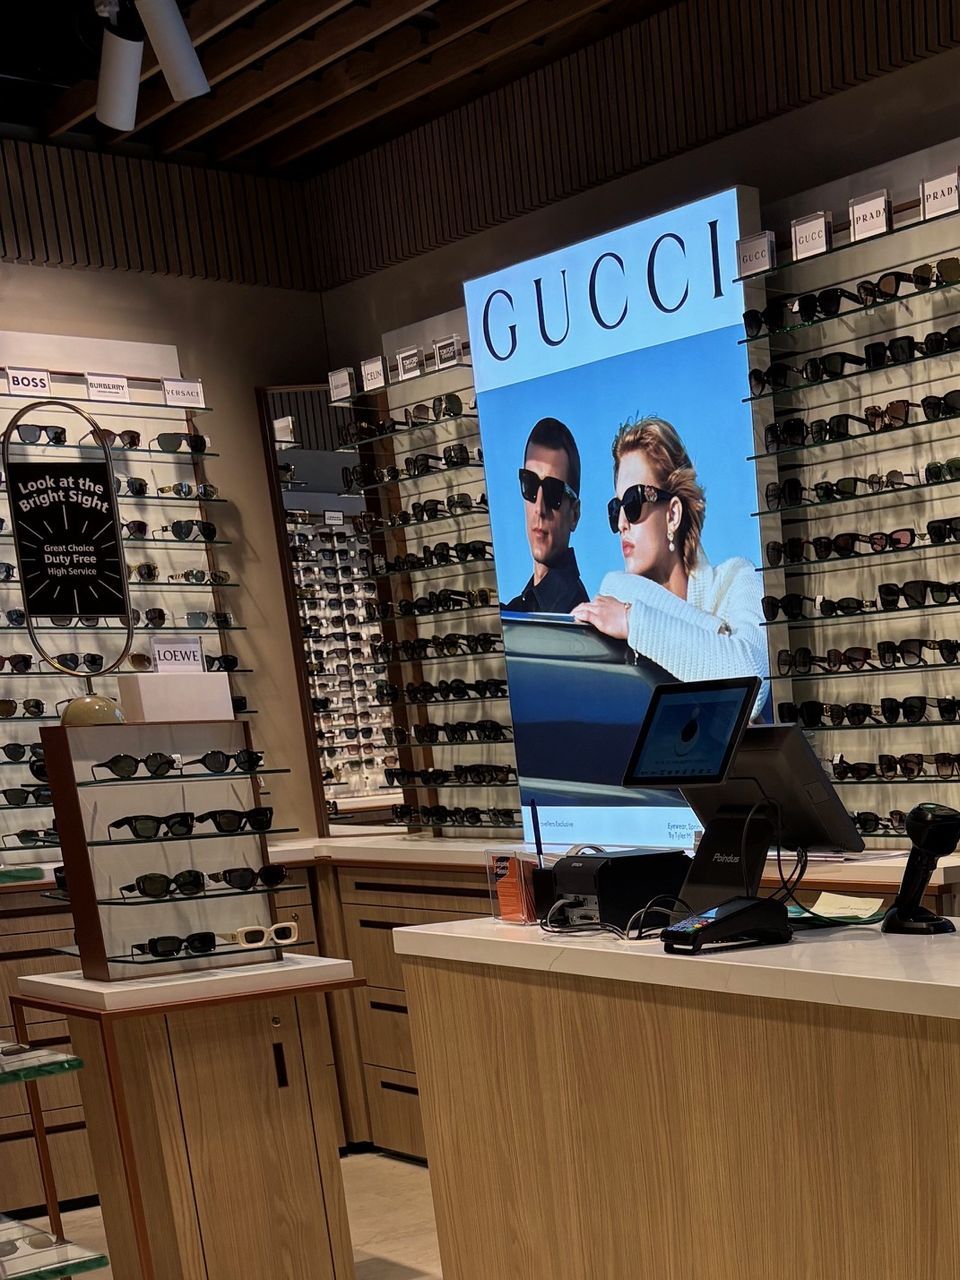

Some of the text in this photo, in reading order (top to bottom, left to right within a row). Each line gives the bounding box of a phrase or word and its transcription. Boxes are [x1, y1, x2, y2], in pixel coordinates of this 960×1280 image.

[798, 230, 823, 245] GUCC
[742, 249, 767, 264] GUCC
[482, 219, 725, 362] GUCCI
[12, 375, 47, 389] BOSS
[367, 369, 382, 382] CELIN
[18, 475, 104, 494] Look at the
[19, 489, 110, 514] Bright Sight
[43, 544, 95, 552] Great Choice
[44, 554, 97, 565] Duty Free
[47, 567, 97, 577] High Service
[157, 650, 200, 662] LOEWE
